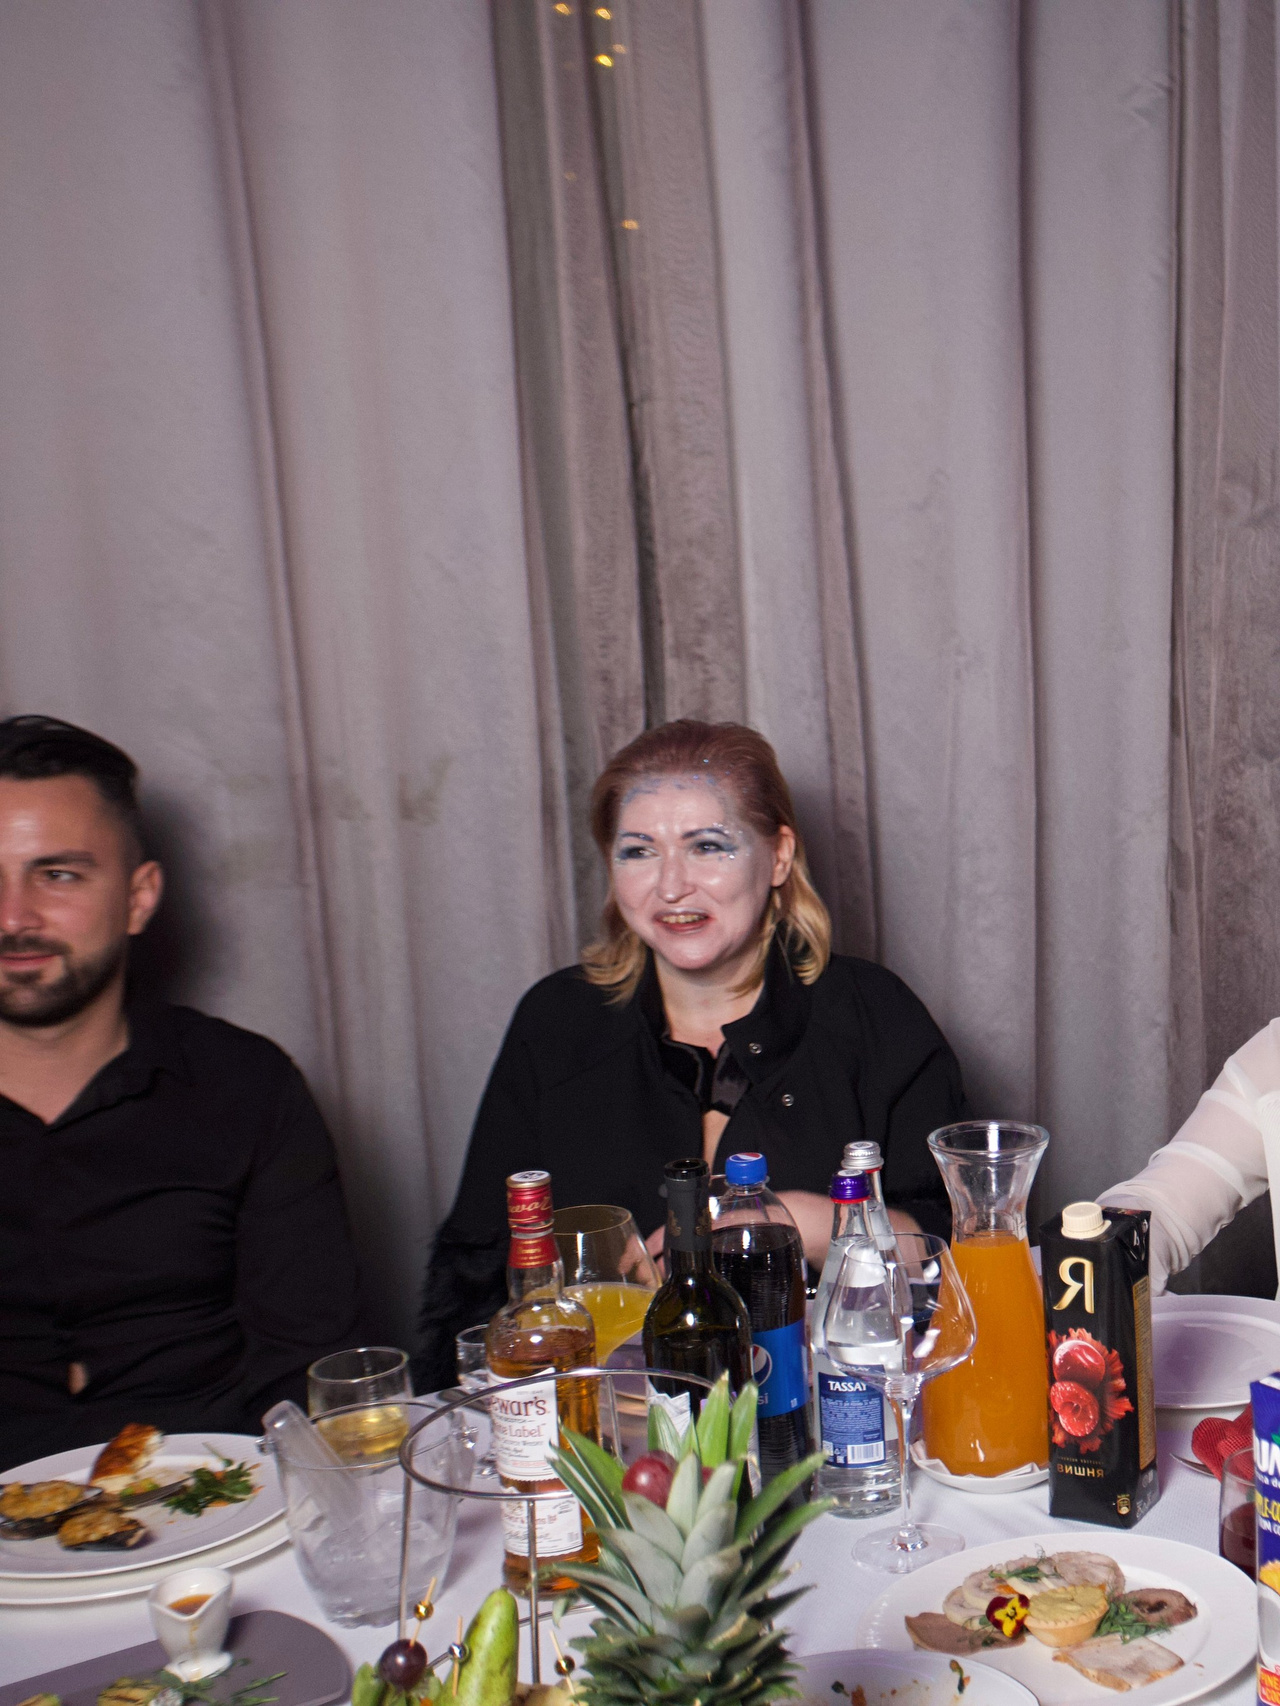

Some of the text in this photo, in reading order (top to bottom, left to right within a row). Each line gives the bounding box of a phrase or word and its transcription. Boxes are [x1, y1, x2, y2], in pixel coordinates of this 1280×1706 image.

[1053, 1256, 1095, 1314] Я
[490, 1395, 547, 1416] ewar's
[509, 1425, 545, 1438] Label
[1057, 1463, 1104, 1478] ВИШНЯ
